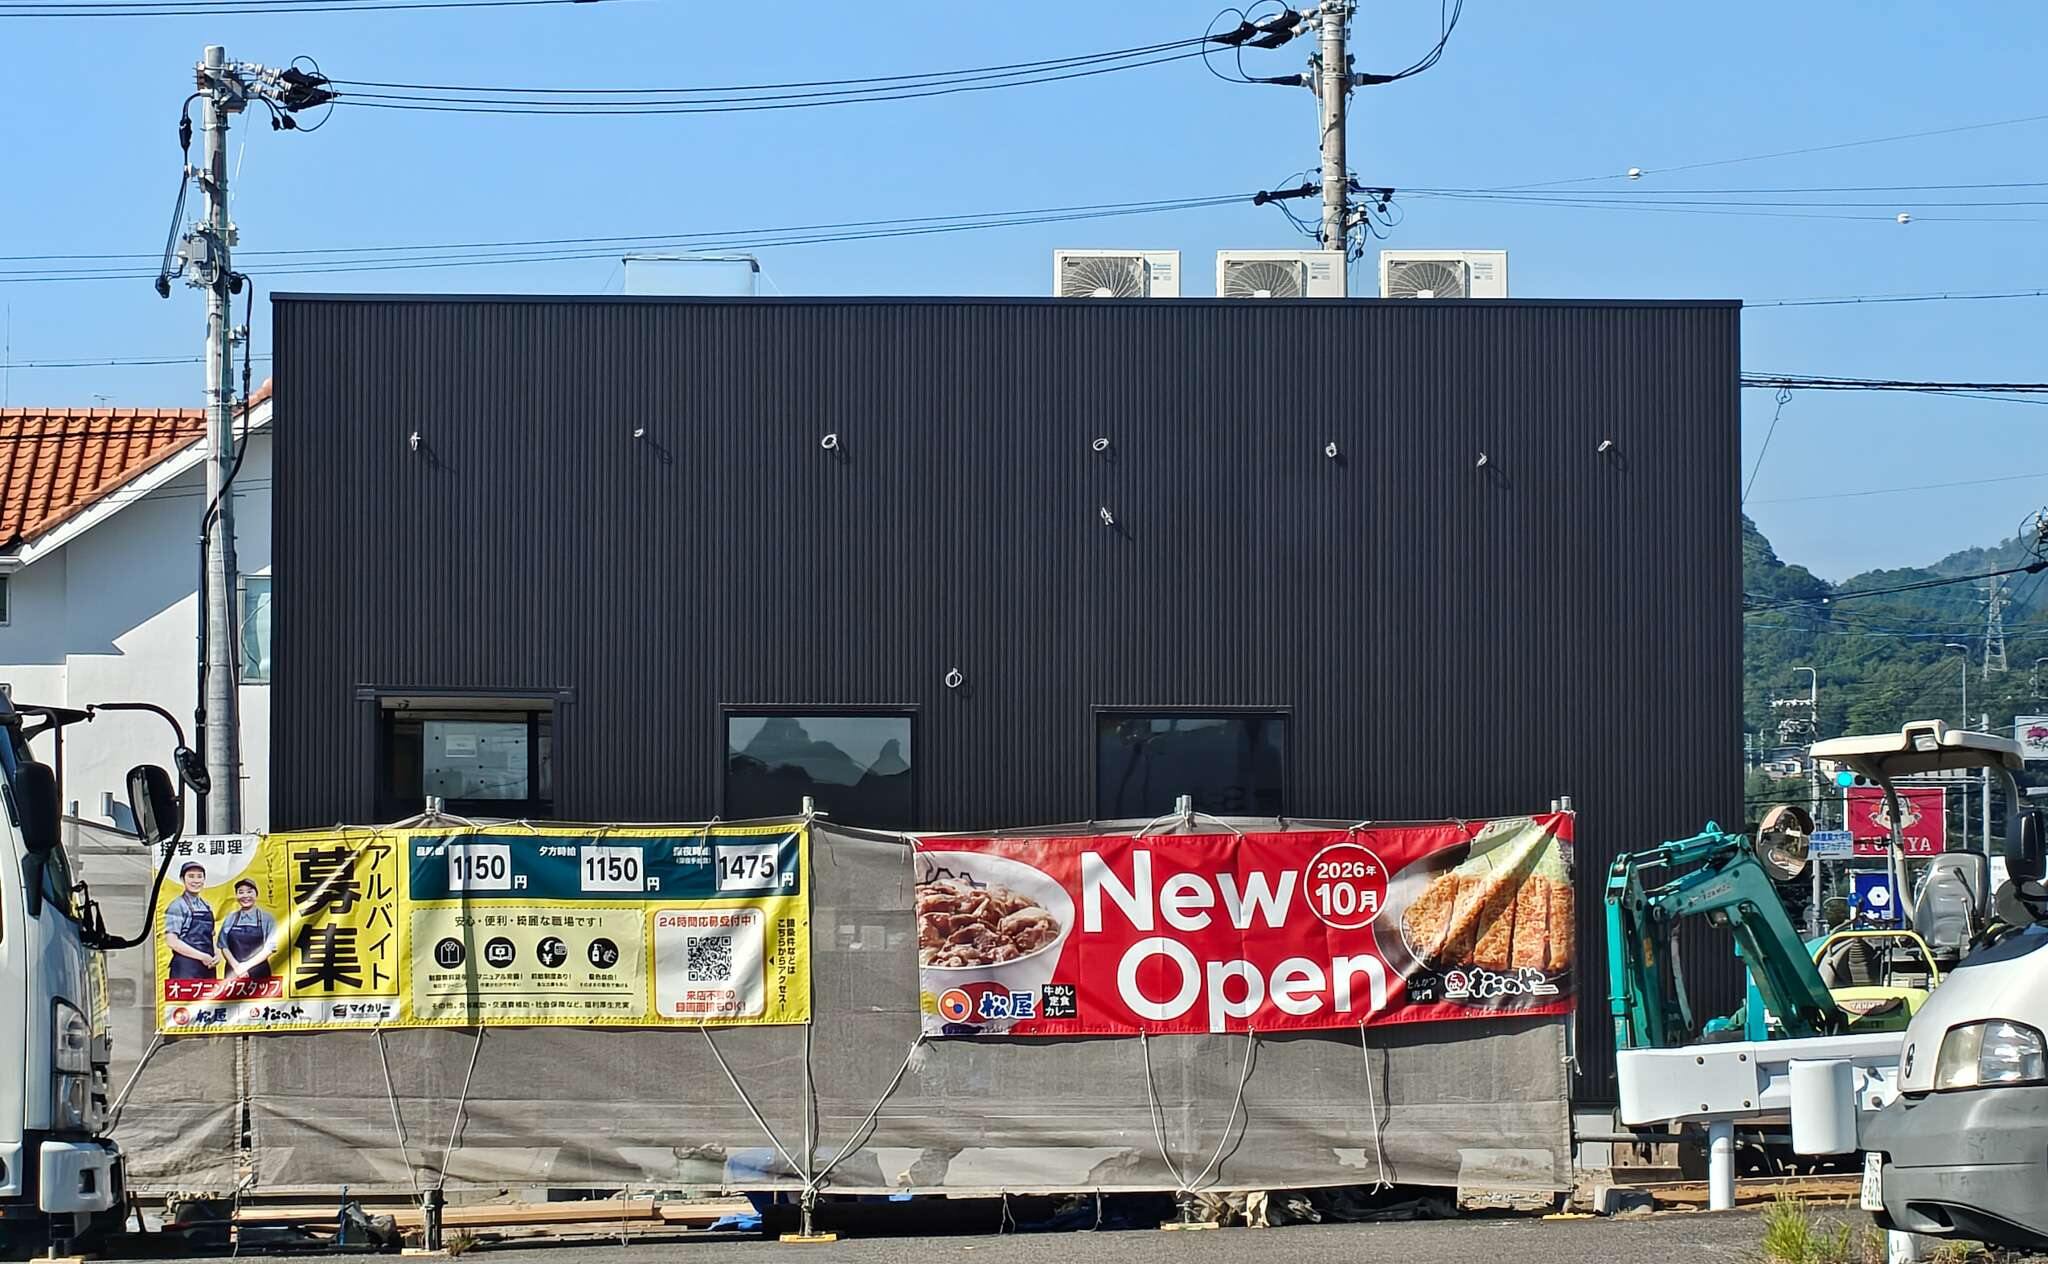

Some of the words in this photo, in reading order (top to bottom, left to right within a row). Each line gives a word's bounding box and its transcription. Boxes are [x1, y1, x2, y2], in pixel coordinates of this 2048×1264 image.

[538, 845, 577, 857] 夕方時給
[1859, 835, 1932, 852] FUYA
[453, 855, 505, 880] 1150
[514, 875, 528, 890] 円
[586, 857, 639, 882] 1150
[646, 876, 660, 891] 円
[719, 855, 775, 880] 1475
[781, 871, 794, 887] 円
[1317, 861, 1377, 879] 2026年
[1082, 850, 1298, 934] New
[1315, 881, 1378, 916] 10月
[293, 846, 364, 992] 募集
[365, 844, 393, 990] アルバイト
[168, 979, 282, 998] オープニングスタッフ
[1043, 985, 1074, 996] 牛めし
[1117, 937, 1387, 1033] Open
[1468, 968, 1546, 998] 松のや
[349, 1003, 391, 1013] マイカリー
[978, 991, 1035, 1018] 松屋
[1045, 1005, 1076, 1017] カレー
[1049, 996, 1071, 1006] 定食
[196, 1007, 227, 1023] 松屋
[262, 1006, 305, 1021] 松のや
